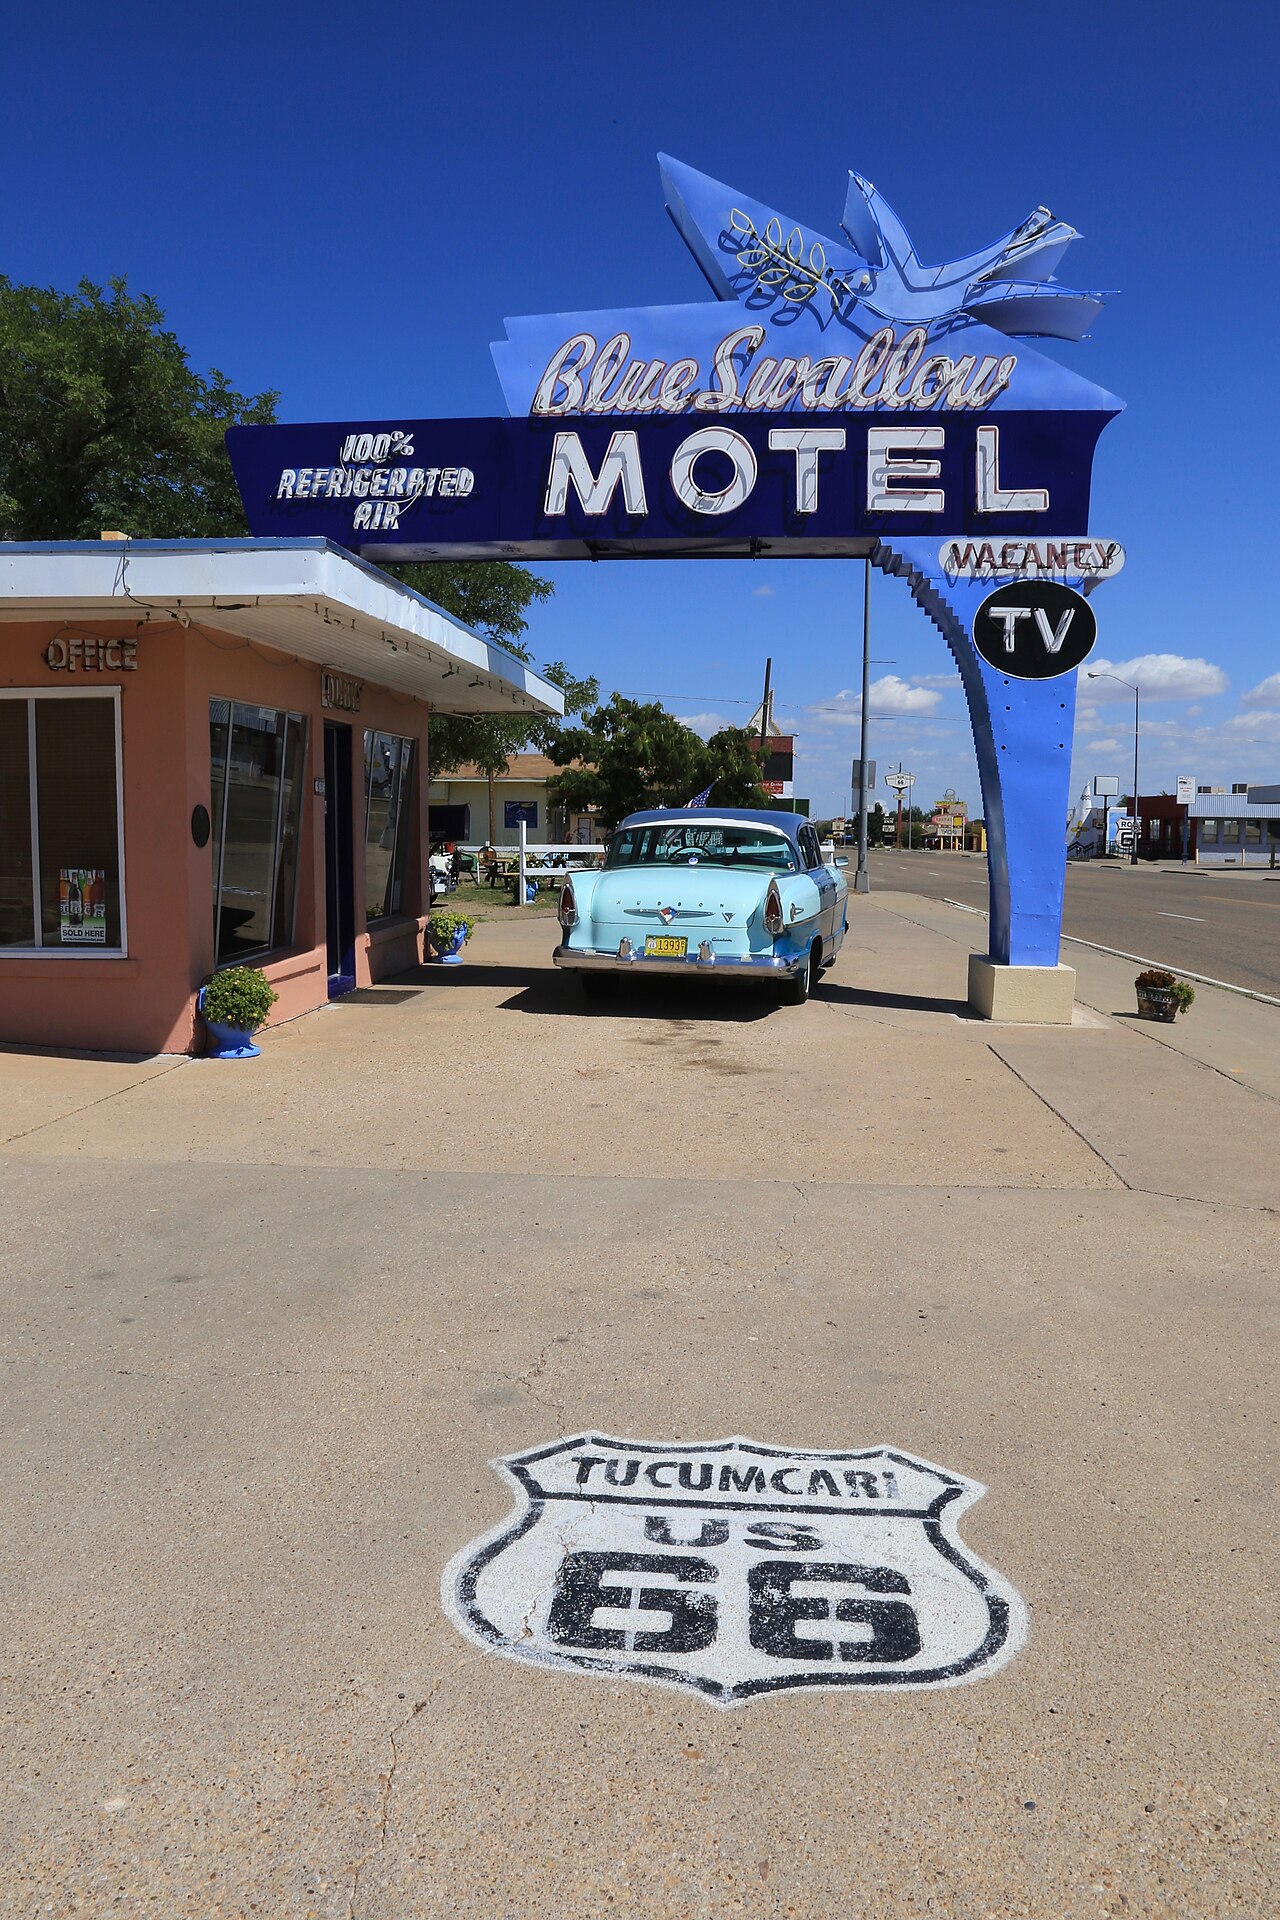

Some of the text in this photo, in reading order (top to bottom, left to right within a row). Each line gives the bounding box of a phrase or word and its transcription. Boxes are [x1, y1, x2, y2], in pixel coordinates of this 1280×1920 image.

[530, 325, 1018, 417] Blue Swallow
[341, 430, 415, 463] 100%
[276, 467, 475, 499] REFRIGERATED
[543, 425, 1050, 517] MOTEL
[353, 501, 400, 530] AIR
[950, 542, 1121, 571] VACANCY
[987, 606, 1076, 654] TV
[47, 638, 138, 672] OFFICE
[62, 929, 105, 938] SOLD HERE
[658, 939, 680, 951] 1393
[571, 1456, 898, 1499] TUCUMCARI
[644, 1516, 824, 1551] US
[546, 1551, 921, 1662] 66
